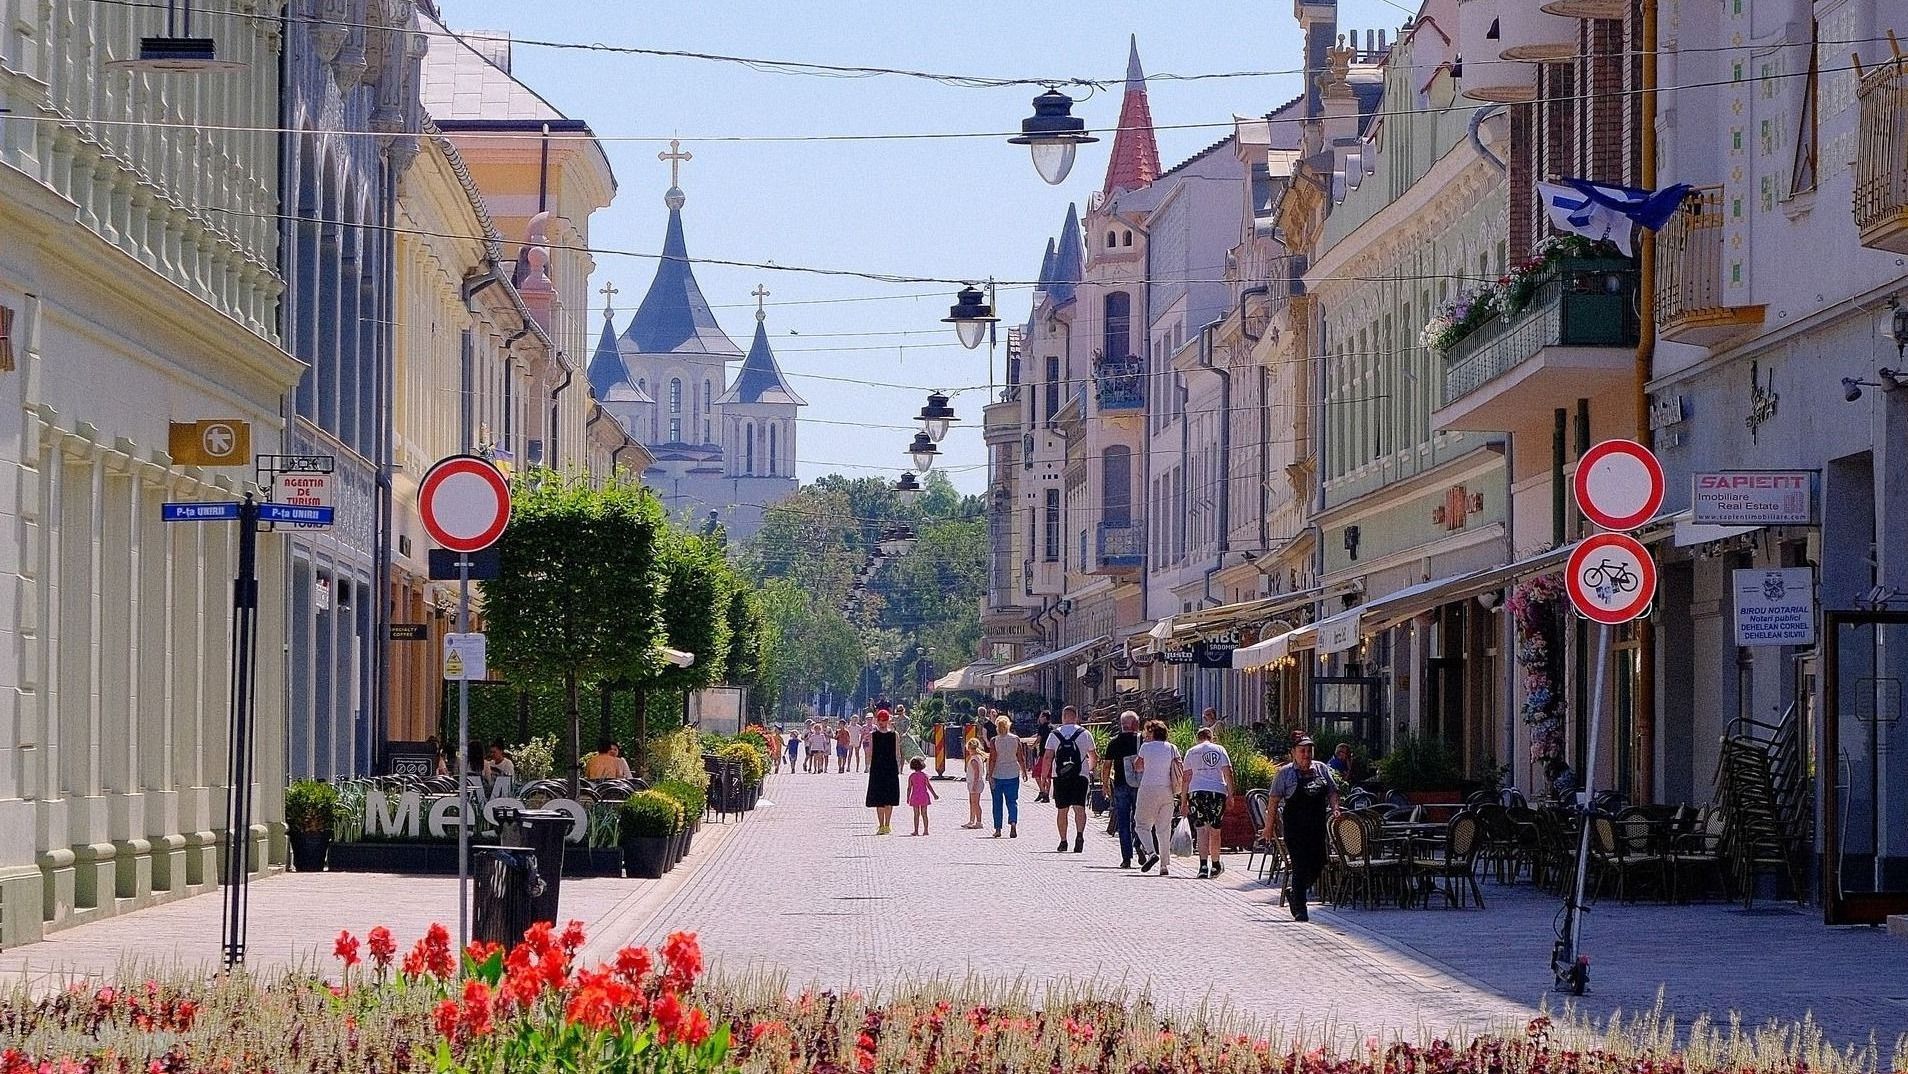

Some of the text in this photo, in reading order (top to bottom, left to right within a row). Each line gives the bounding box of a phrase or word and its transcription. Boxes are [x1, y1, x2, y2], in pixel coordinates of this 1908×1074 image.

[1699, 476, 1805, 489] SAPIENT
[297, 488, 310, 496] DE
[1698, 493, 1749, 501] Imobiliare
[1718, 502, 1779, 510] Real Estate
[292, 509, 320, 520] UNIRII
[1740, 606, 1809, 615] BIROU NOTARIAL
[1775, 615, 1801, 623] publici
[1741, 623, 1779, 631] DEHELEAN
[1744, 631, 1782, 639] DEHELEAN
